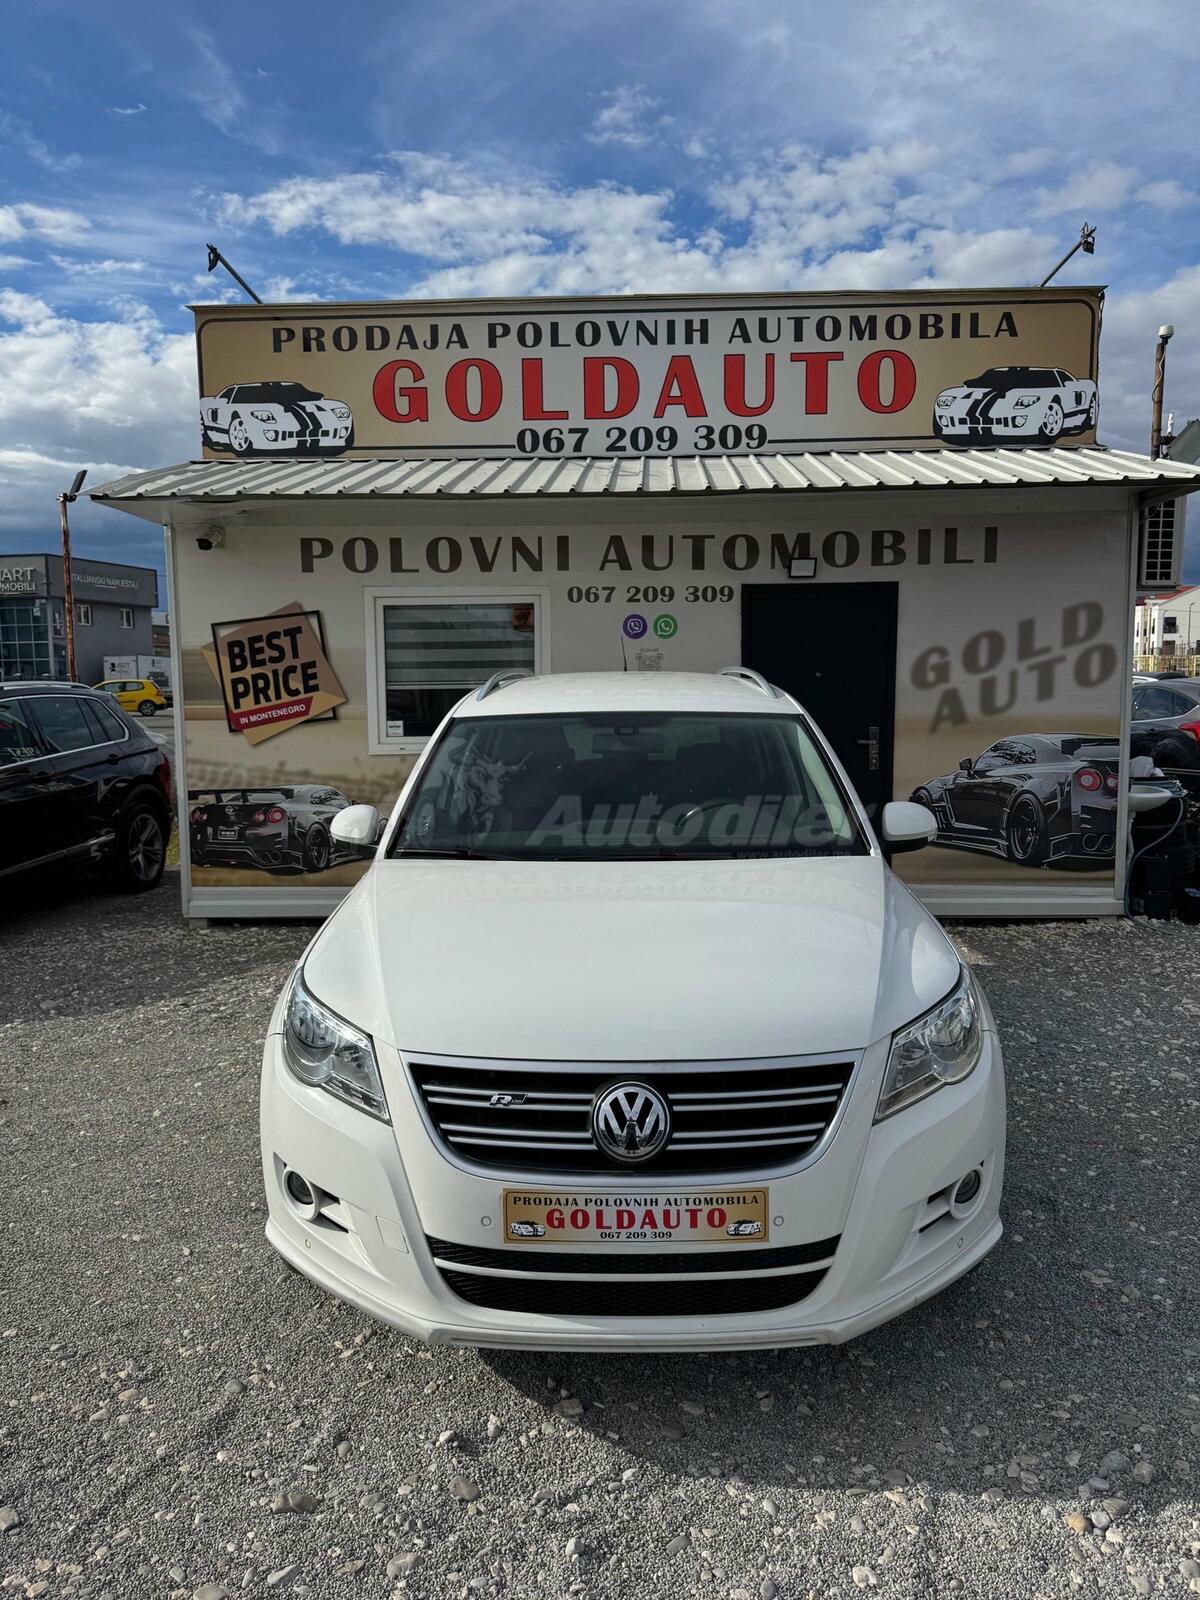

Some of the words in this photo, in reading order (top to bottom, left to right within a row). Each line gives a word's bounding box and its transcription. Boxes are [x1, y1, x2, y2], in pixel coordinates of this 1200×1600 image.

[272, 323, 469, 354] PRODAJA
[487, 318, 709, 349] POLOVNIH
[728, 311, 1019, 345] AUTOMOBILA
[372, 349, 917, 424] GOLDAUTO
[516, 427, 590, 453] 067
[605, 425, 679, 452] 209
[693, 423, 769, 450] 309
[300, 535, 571, 573] POLOVNI
[599, 526, 999, 572] AUTOMOBILI
[0, 567, 35, 582] ART
[567, 586, 616, 603] 067
[626, 585, 675, 603] 209
[685, 585, 734, 603] 309
[227, 626, 303, 673] BEST
[909, 601, 1104, 691] GOLD
[231, 660, 320, 710] PRICE
[929, 641, 1118, 734] AUTO
[240, 716, 249, 725] IN
[250, 703, 307, 723] MONTENEGRO
[512, 1195, 578, 1207] PRODAJA
[584, 1197, 659, 1207] POLOVNIH
[664, 1194, 759, 1207] AUTOMOBILA
[546, 1207, 728, 1230] GOLDAUTO
[600, 1231, 622, 1240] 067
[625, 1231, 647, 1240] 209
[650, 1231, 672, 1240] 309
